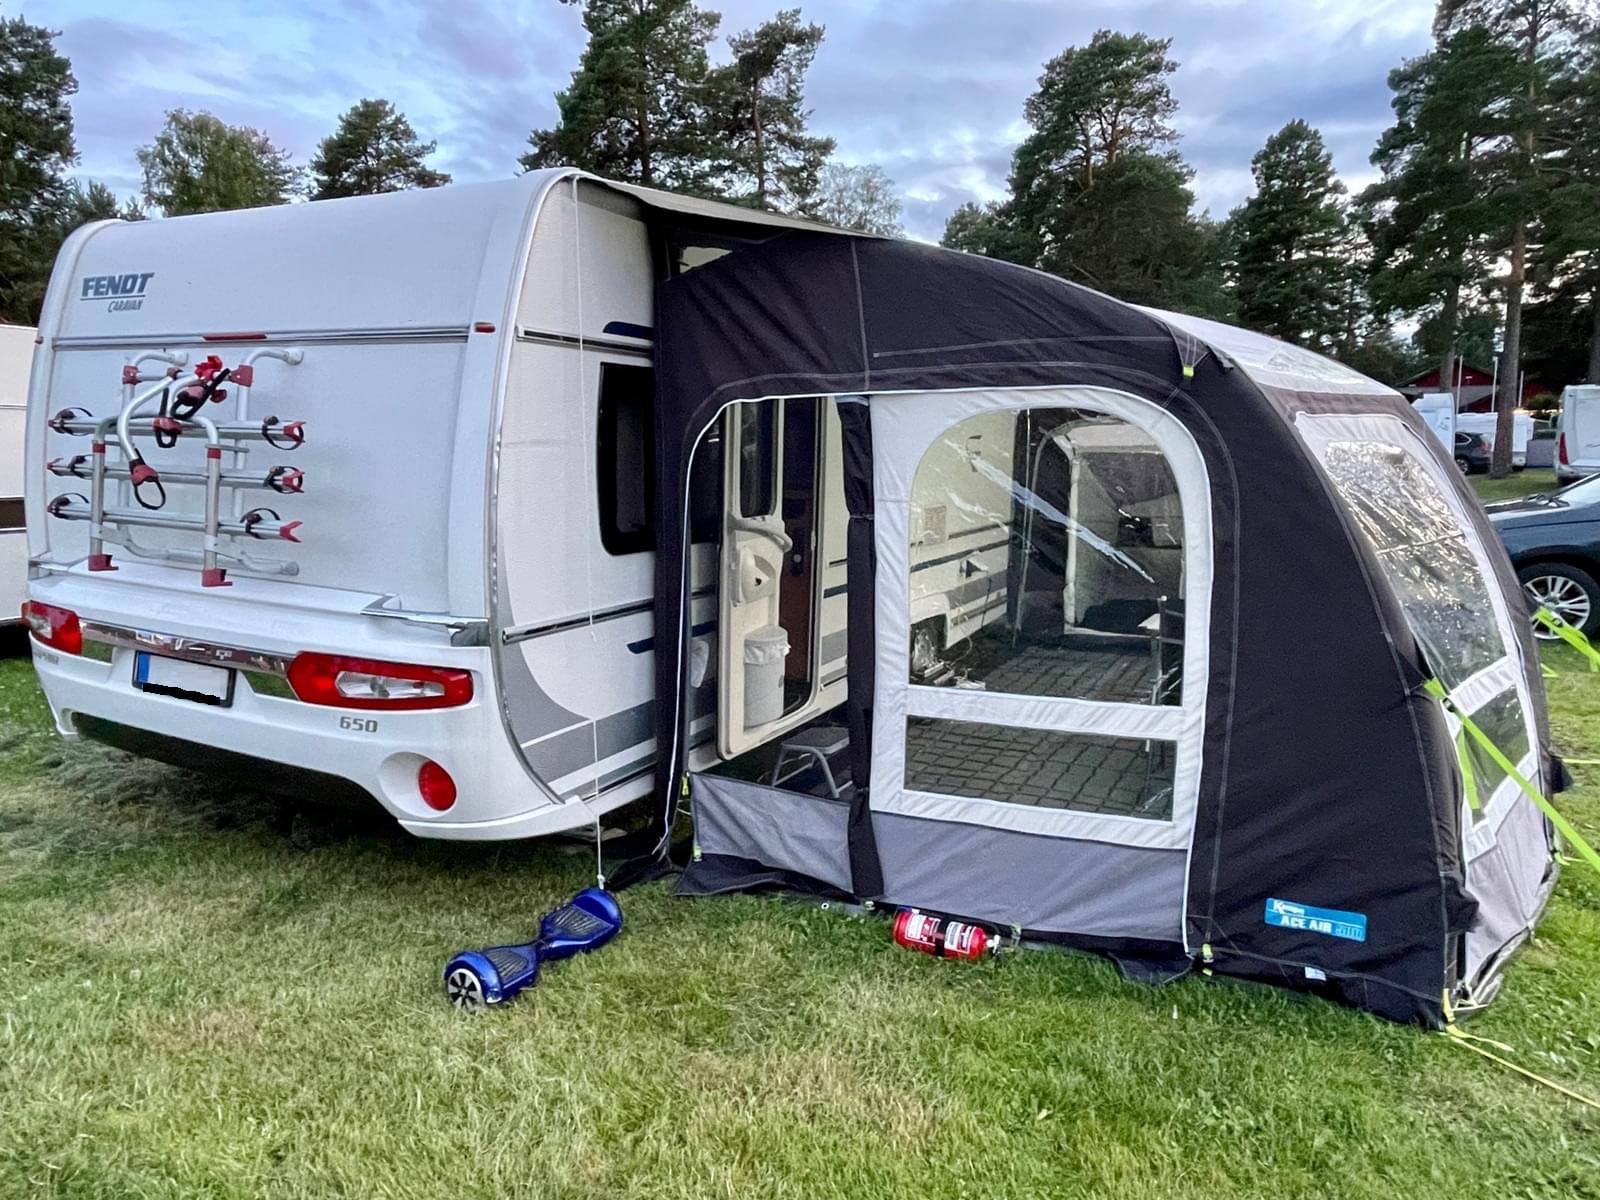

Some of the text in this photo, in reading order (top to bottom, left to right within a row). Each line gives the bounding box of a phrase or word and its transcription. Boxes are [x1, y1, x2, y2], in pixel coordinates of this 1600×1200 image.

[82, 272, 155, 297] FENDT
[340, 716, 378, 733] 650
[1280, 915, 1307, 929] ACE
[1308, 919, 1332, 934] AIR
